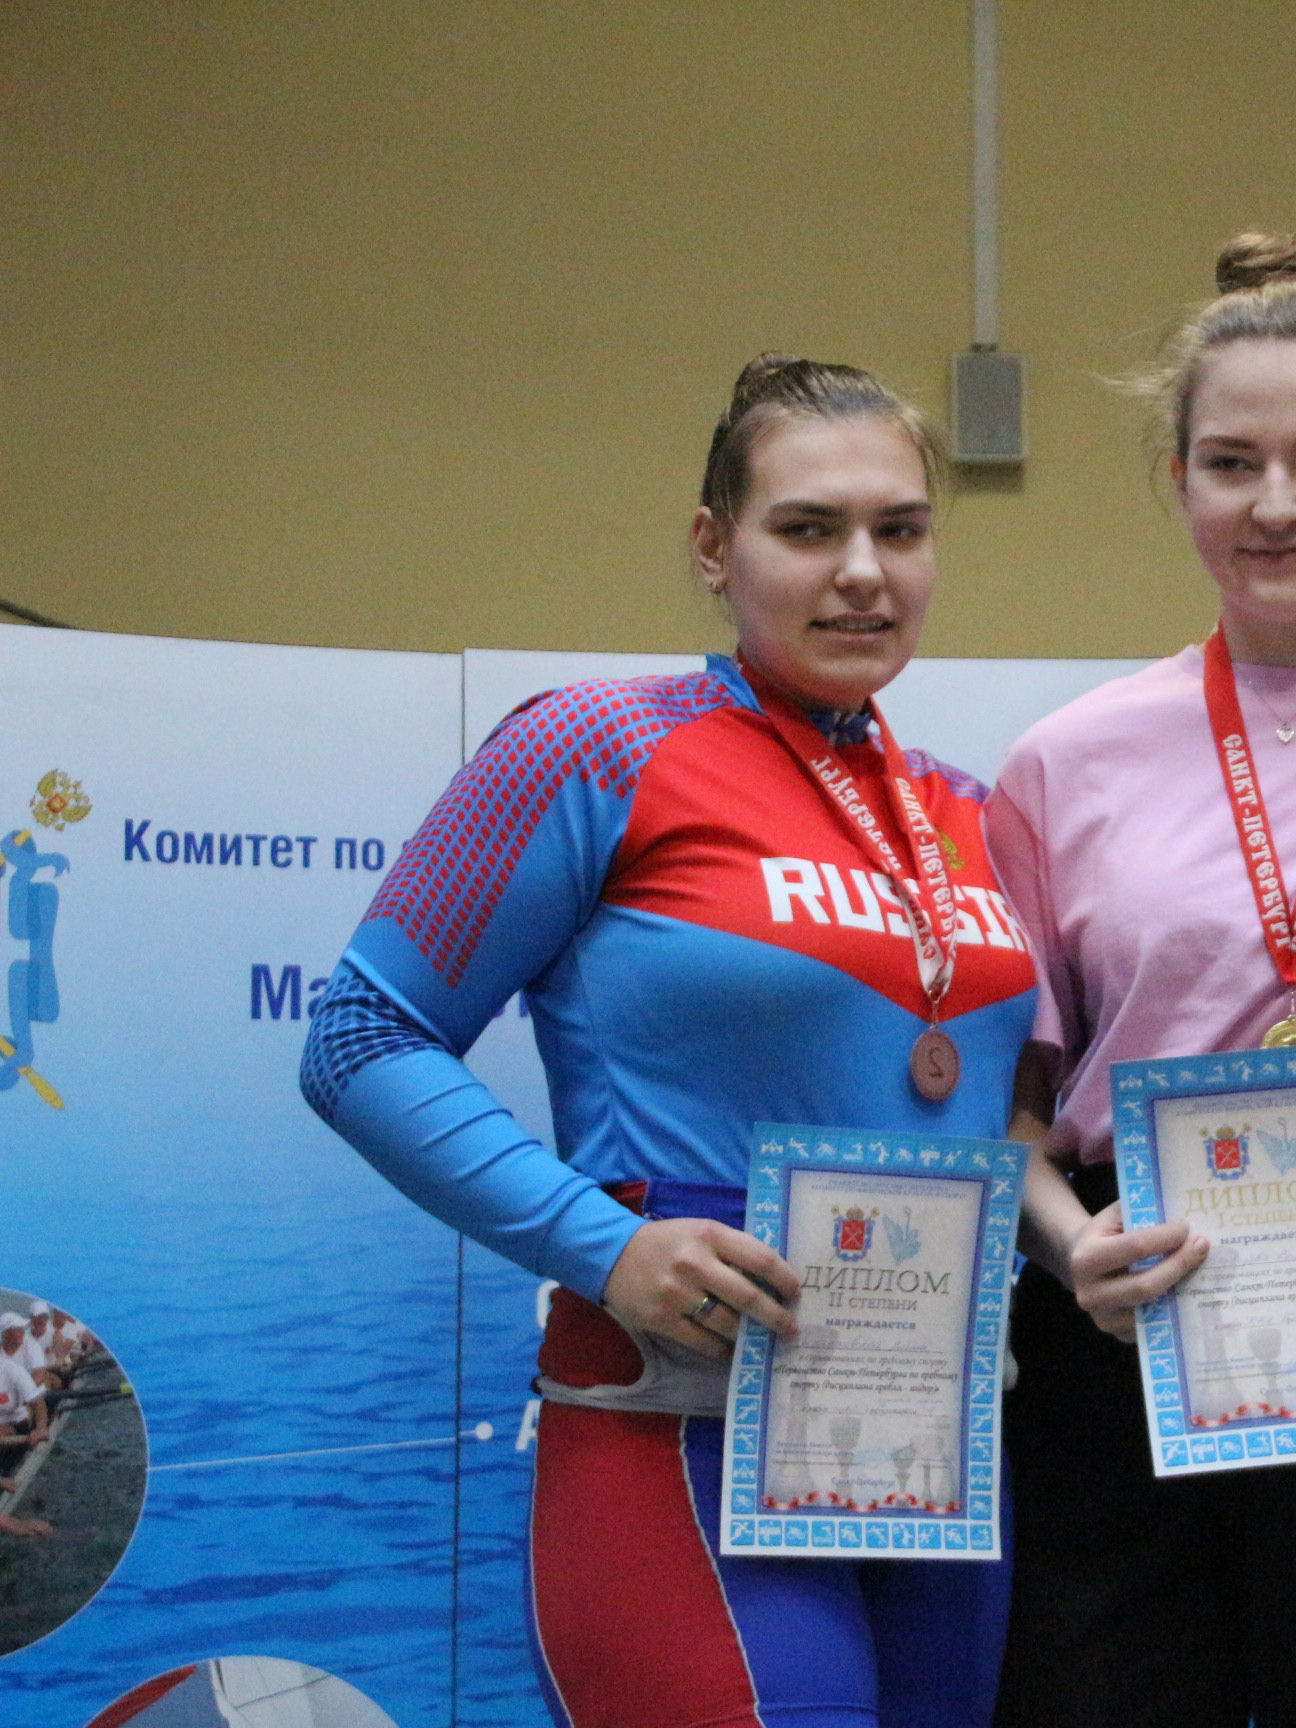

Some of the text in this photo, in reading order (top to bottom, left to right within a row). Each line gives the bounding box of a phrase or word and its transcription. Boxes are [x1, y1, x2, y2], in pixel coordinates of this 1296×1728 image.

[123, 818, 386, 871] Комитет по
[800, 1266, 952, 1295] ДИПЛОМ
[825, 1318, 916, 1330] награждается
